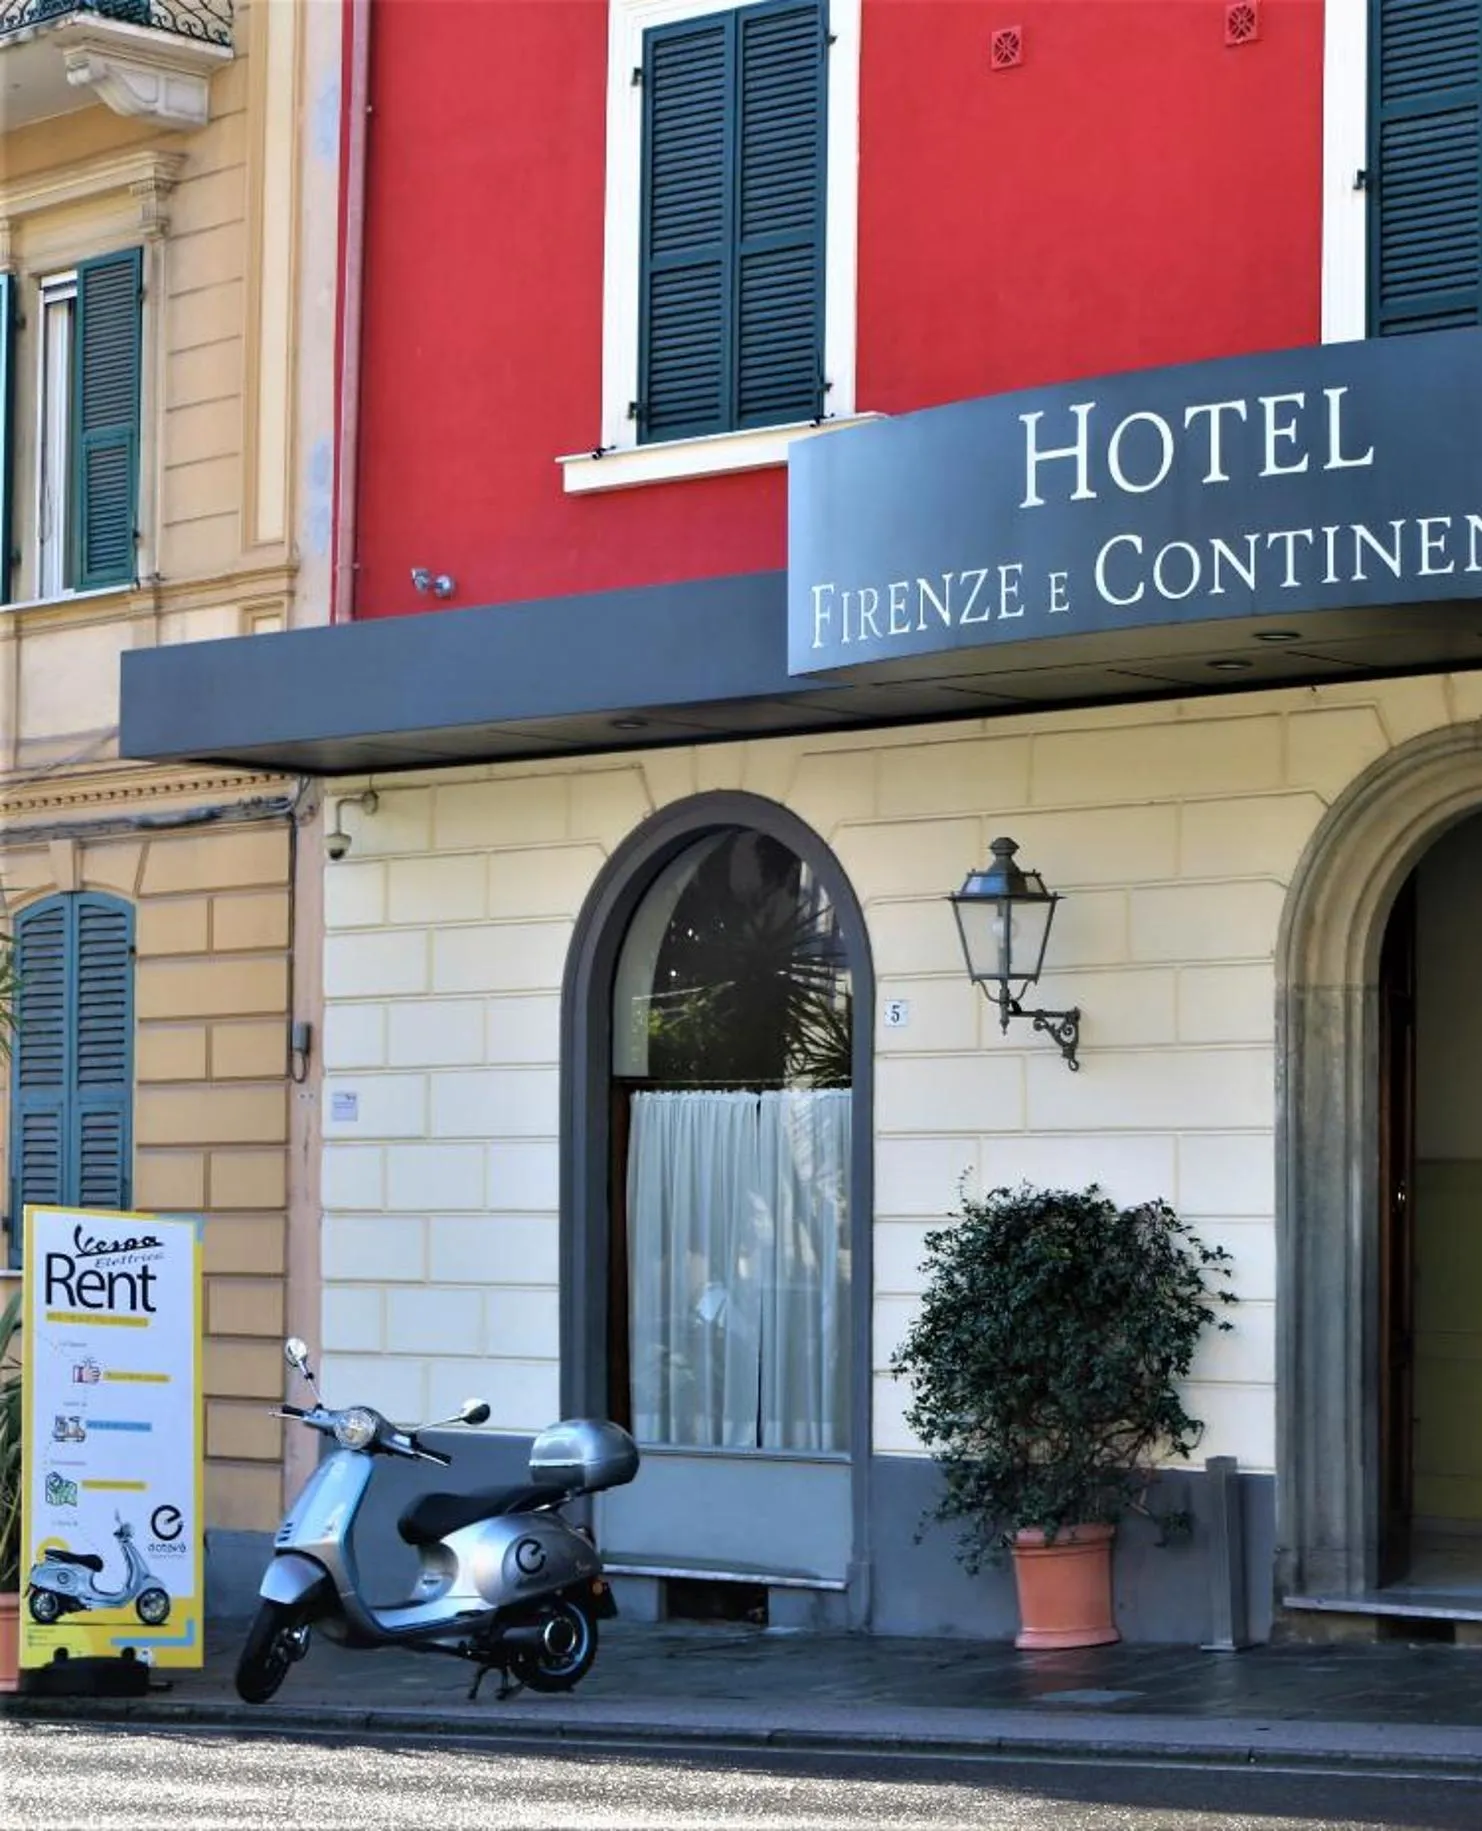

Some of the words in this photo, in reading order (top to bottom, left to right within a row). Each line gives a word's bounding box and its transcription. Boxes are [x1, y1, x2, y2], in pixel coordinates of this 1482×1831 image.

[1019, 387, 1374, 508] HOTEL
[810, 563, 1024, 649] FIRENZE
[1048, 572, 1070, 614] E
[890, 1004, 901, 1023] 5
[73, 1224, 163, 1259] Vespa
[45, 1252, 157, 1313] Rent
